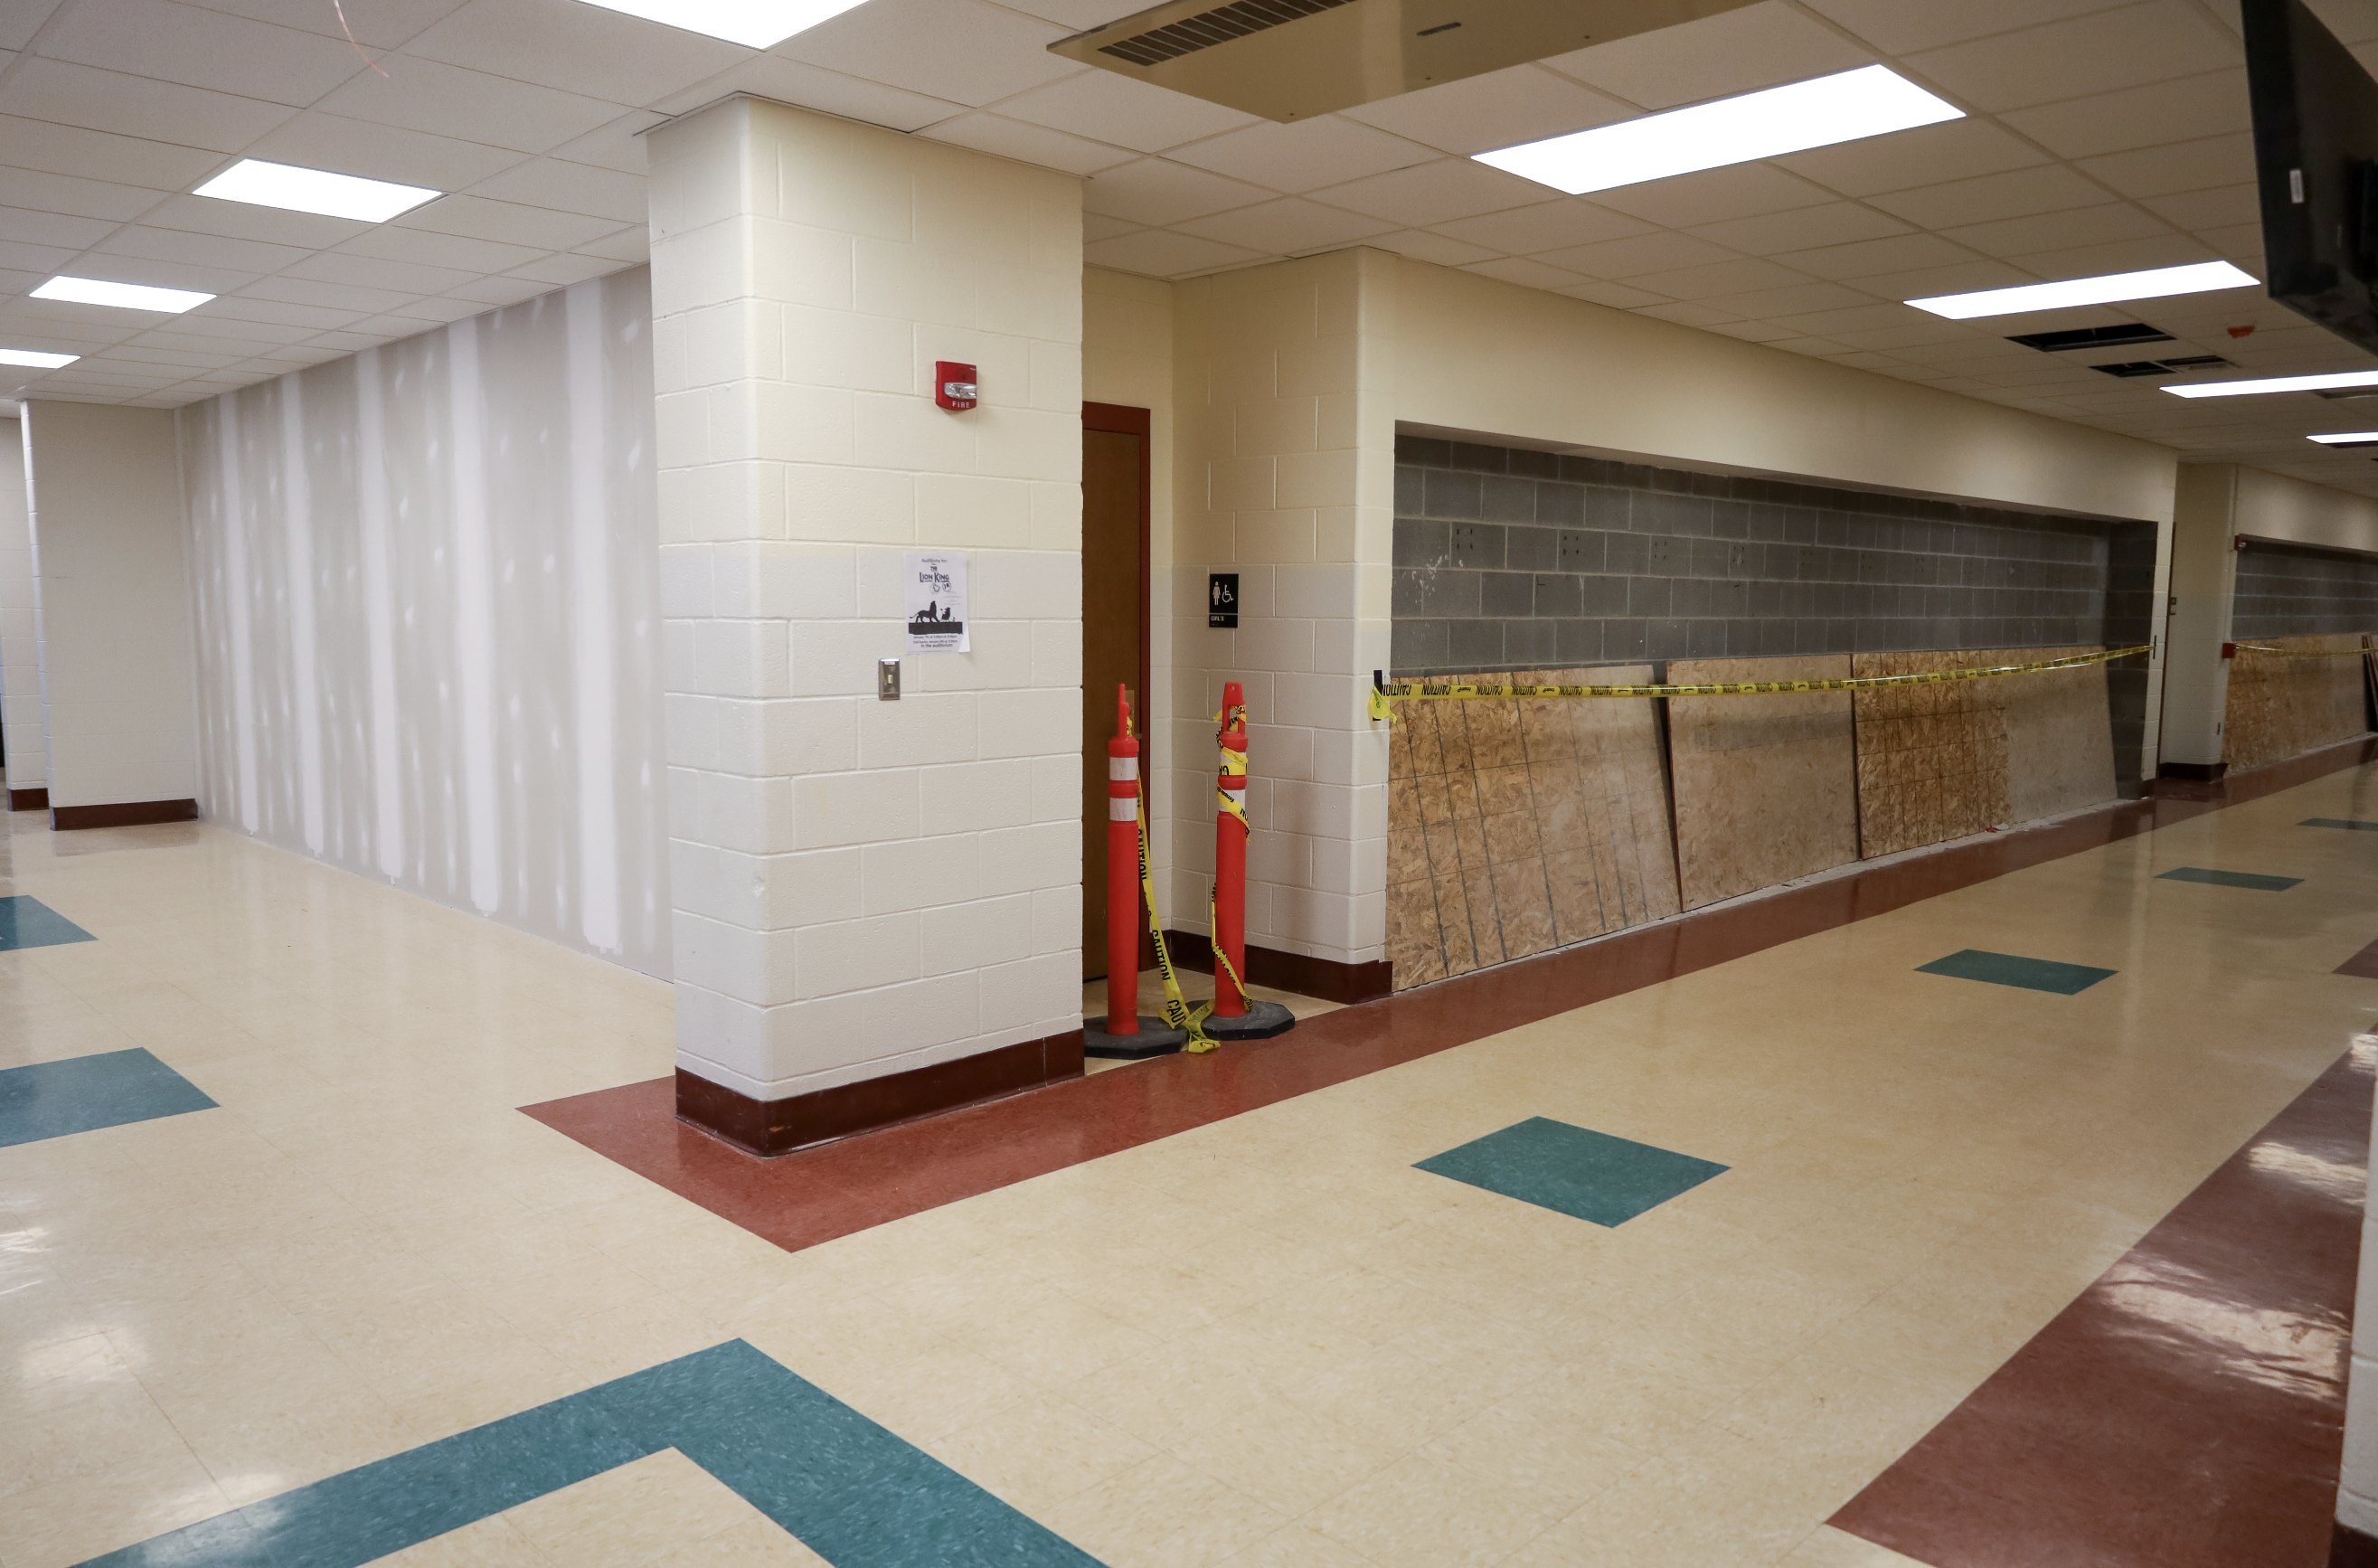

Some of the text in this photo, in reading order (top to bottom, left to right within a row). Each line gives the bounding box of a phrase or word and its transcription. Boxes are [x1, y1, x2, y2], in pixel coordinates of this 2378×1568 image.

[1382, 684, 1411, 695] CAUTION
[1421, 685, 1451, 695] CAUTION
[1476, 685, 1503, 695] CAUTION
[1511, 685, 1537, 695] CAUTION
[1558, 685, 1582, 695] CAUTION
[1590, 685, 1613, 695] CAUTION
[1632, 685, 1653, 695] CAUTION
[1152, 930, 1171, 981] CAUTION
